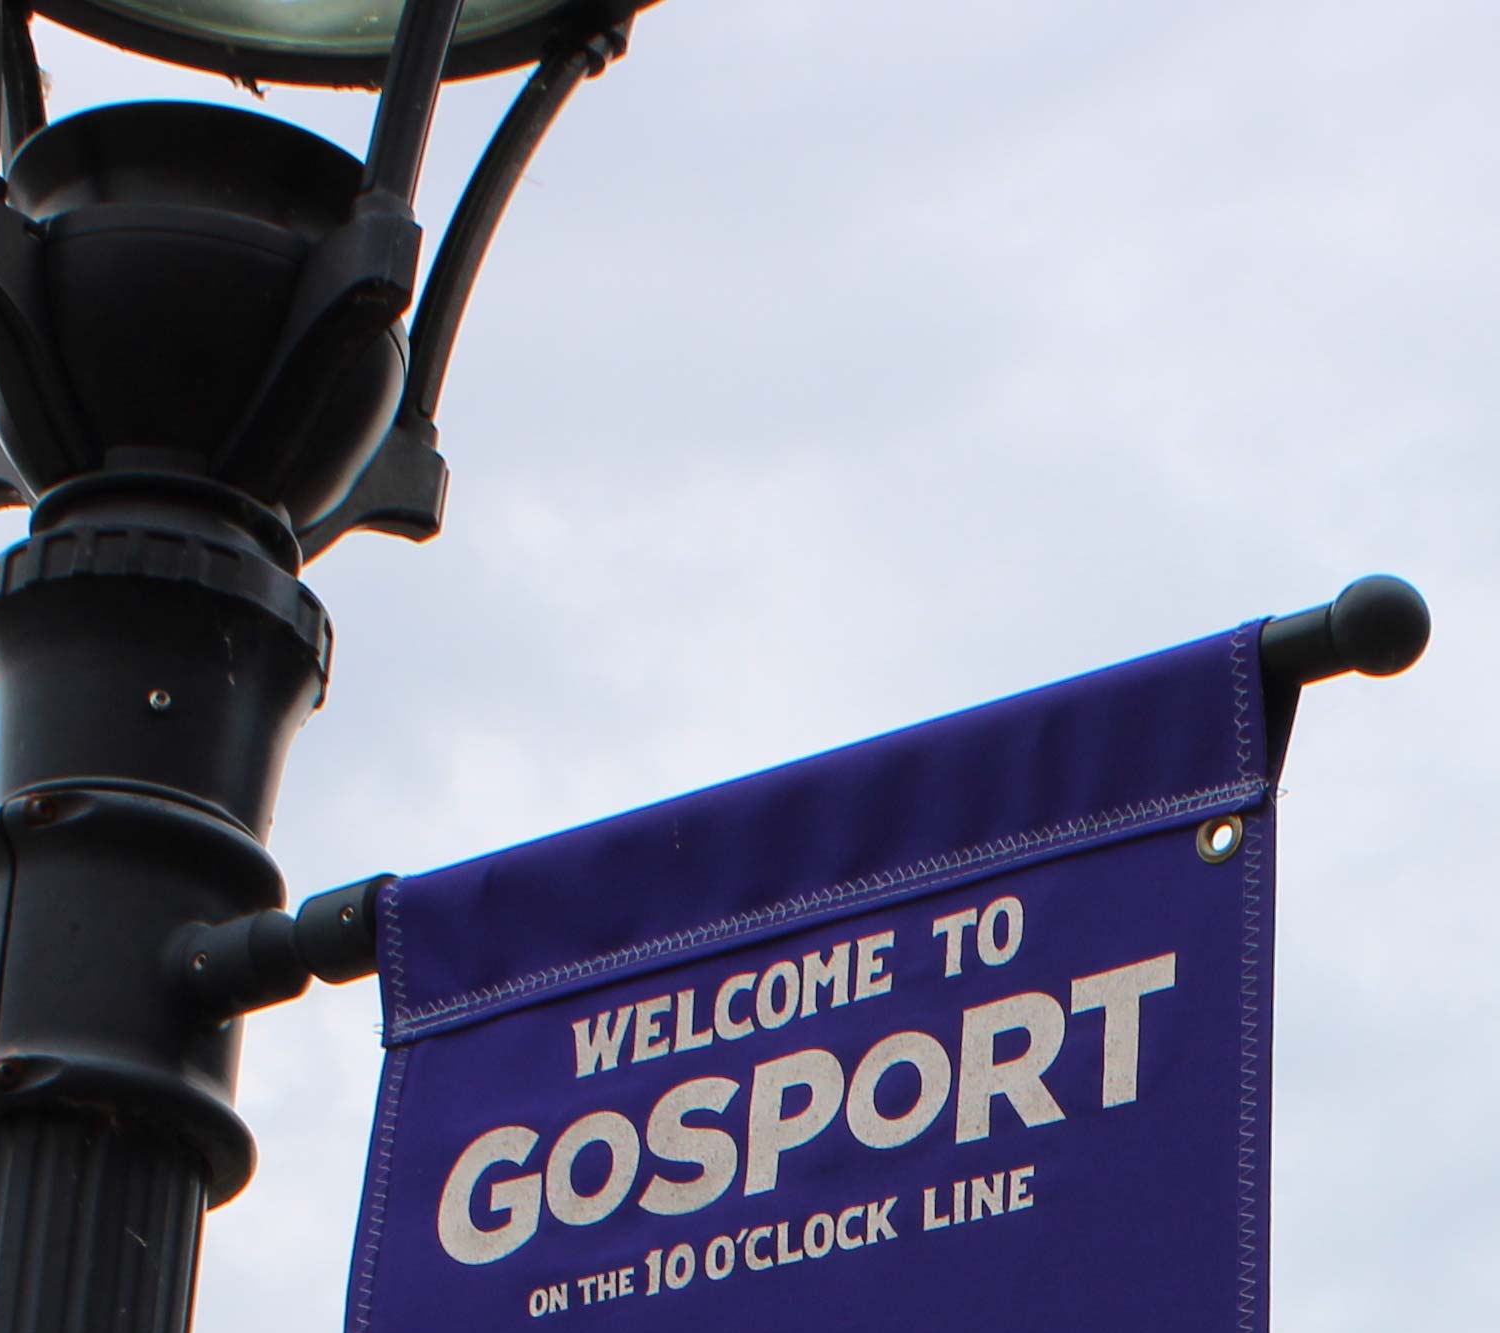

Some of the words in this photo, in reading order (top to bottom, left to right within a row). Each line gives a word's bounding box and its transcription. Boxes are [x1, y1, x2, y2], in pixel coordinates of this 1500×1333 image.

[571, 930, 895, 1079] WELCOME
[932, 896, 1024, 978] TO
[437, 951, 1176, 1266] GOSPORT
[529, 1282, 569, 1318] ON
[577, 1266, 635, 1306] THE
[644, 1243, 696, 1297] 10
[704, 1196, 899, 1281] O'CLOCK
[923, 1165, 1035, 1232] LINE
